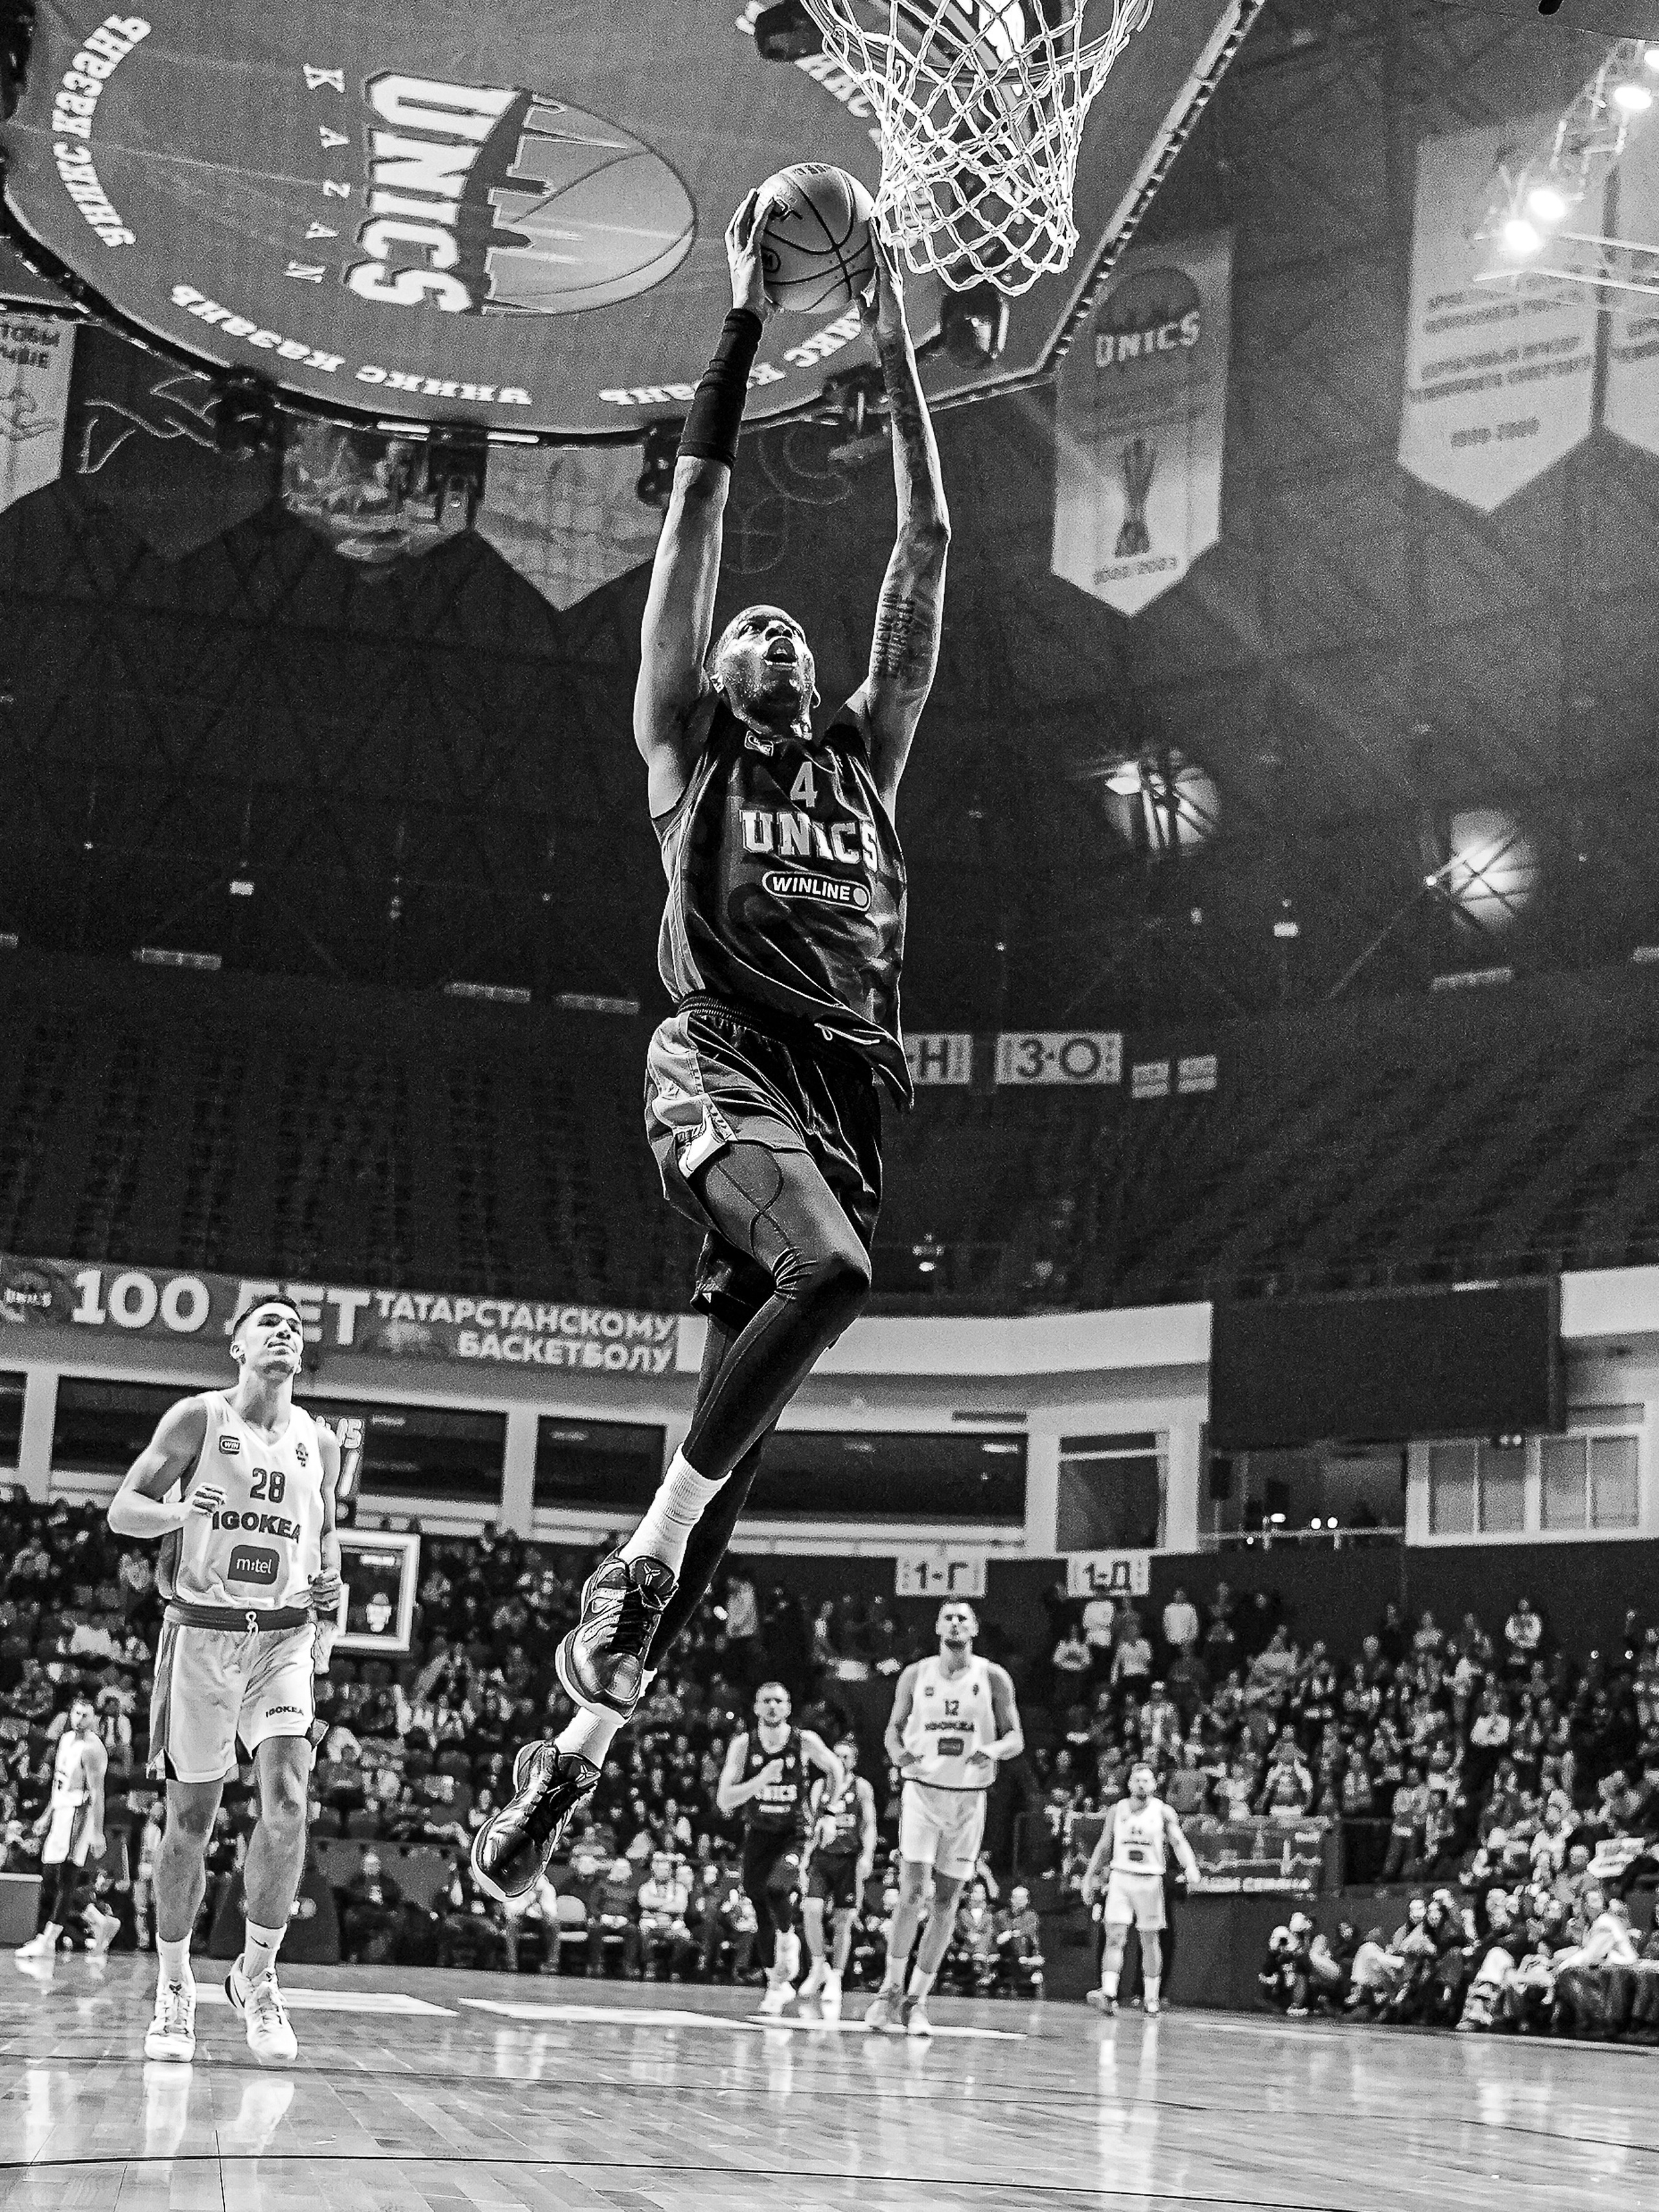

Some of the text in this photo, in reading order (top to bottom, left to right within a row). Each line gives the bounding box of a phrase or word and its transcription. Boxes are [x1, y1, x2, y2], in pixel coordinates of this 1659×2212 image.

[53, 141, 137, 248] УНИКС
[348, 71, 522, 314] UNICS
[1095, 308, 1201, 368] UNICS
[355, 364, 533, 406] УНИКС
[789, 761, 818, 808] 4
[739, 808, 878, 872] UNICS
[772, 876, 851, 902] WINLINE
[907, 1040, 950, 1078] -Н
[72, 1268, 209, 1333] 100
[375, 1290, 675, 1342] ТАТАРСТАНСКОМУ
[458, 1330, 673, 1375] БАСКЕТБОЛУ
[249, 1467, 286, 1504] 28
[211, 1510, 301, 1544] IGOKEA
